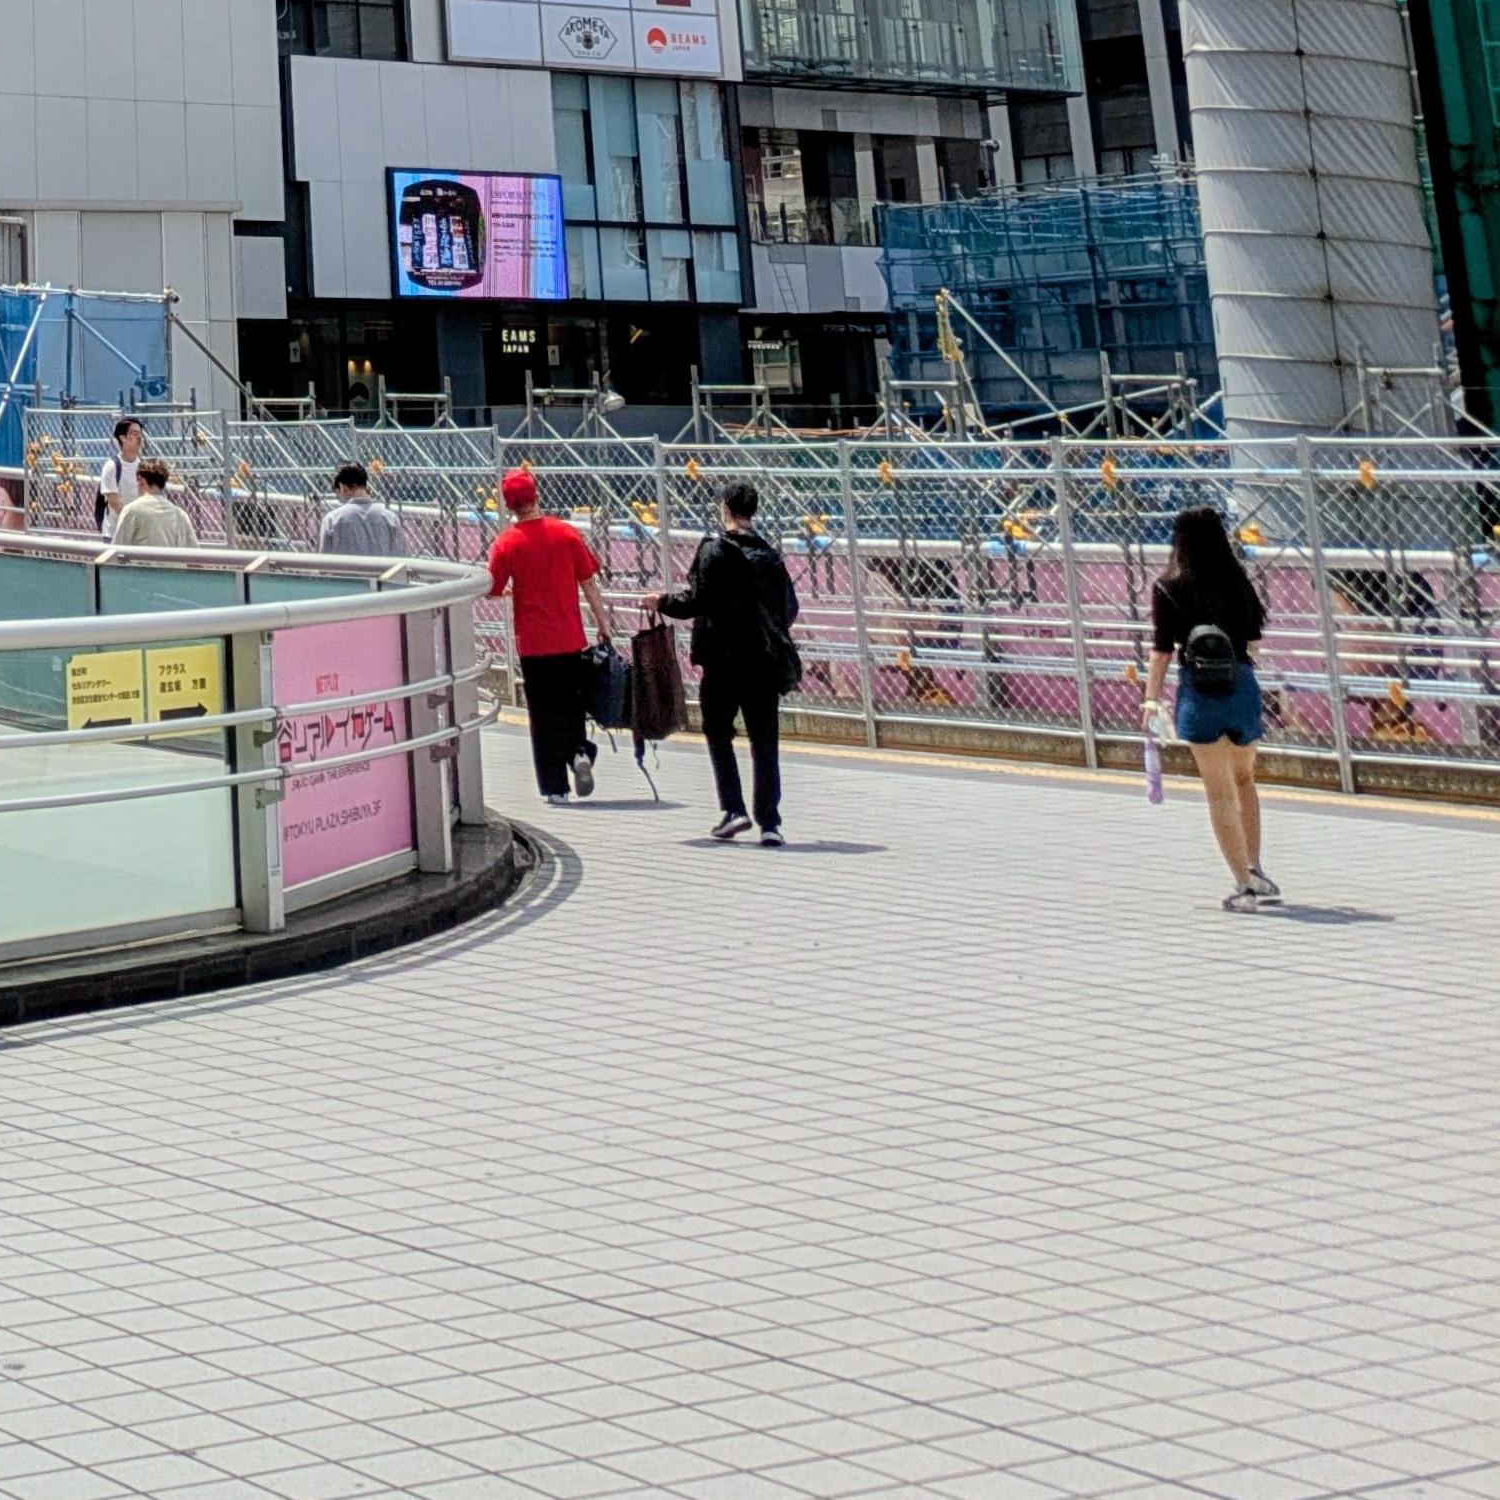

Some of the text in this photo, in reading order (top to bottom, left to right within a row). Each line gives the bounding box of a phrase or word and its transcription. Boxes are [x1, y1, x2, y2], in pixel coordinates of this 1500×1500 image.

[671, 33, 707, 46] BEAMS
[502, 344, 529, 353] JAPAN
[159, 664, 186, 676] フクラス
[159, 678, 207, 693] 道玄坂 方面
[316, 674, 340, 694] NETFLIX
